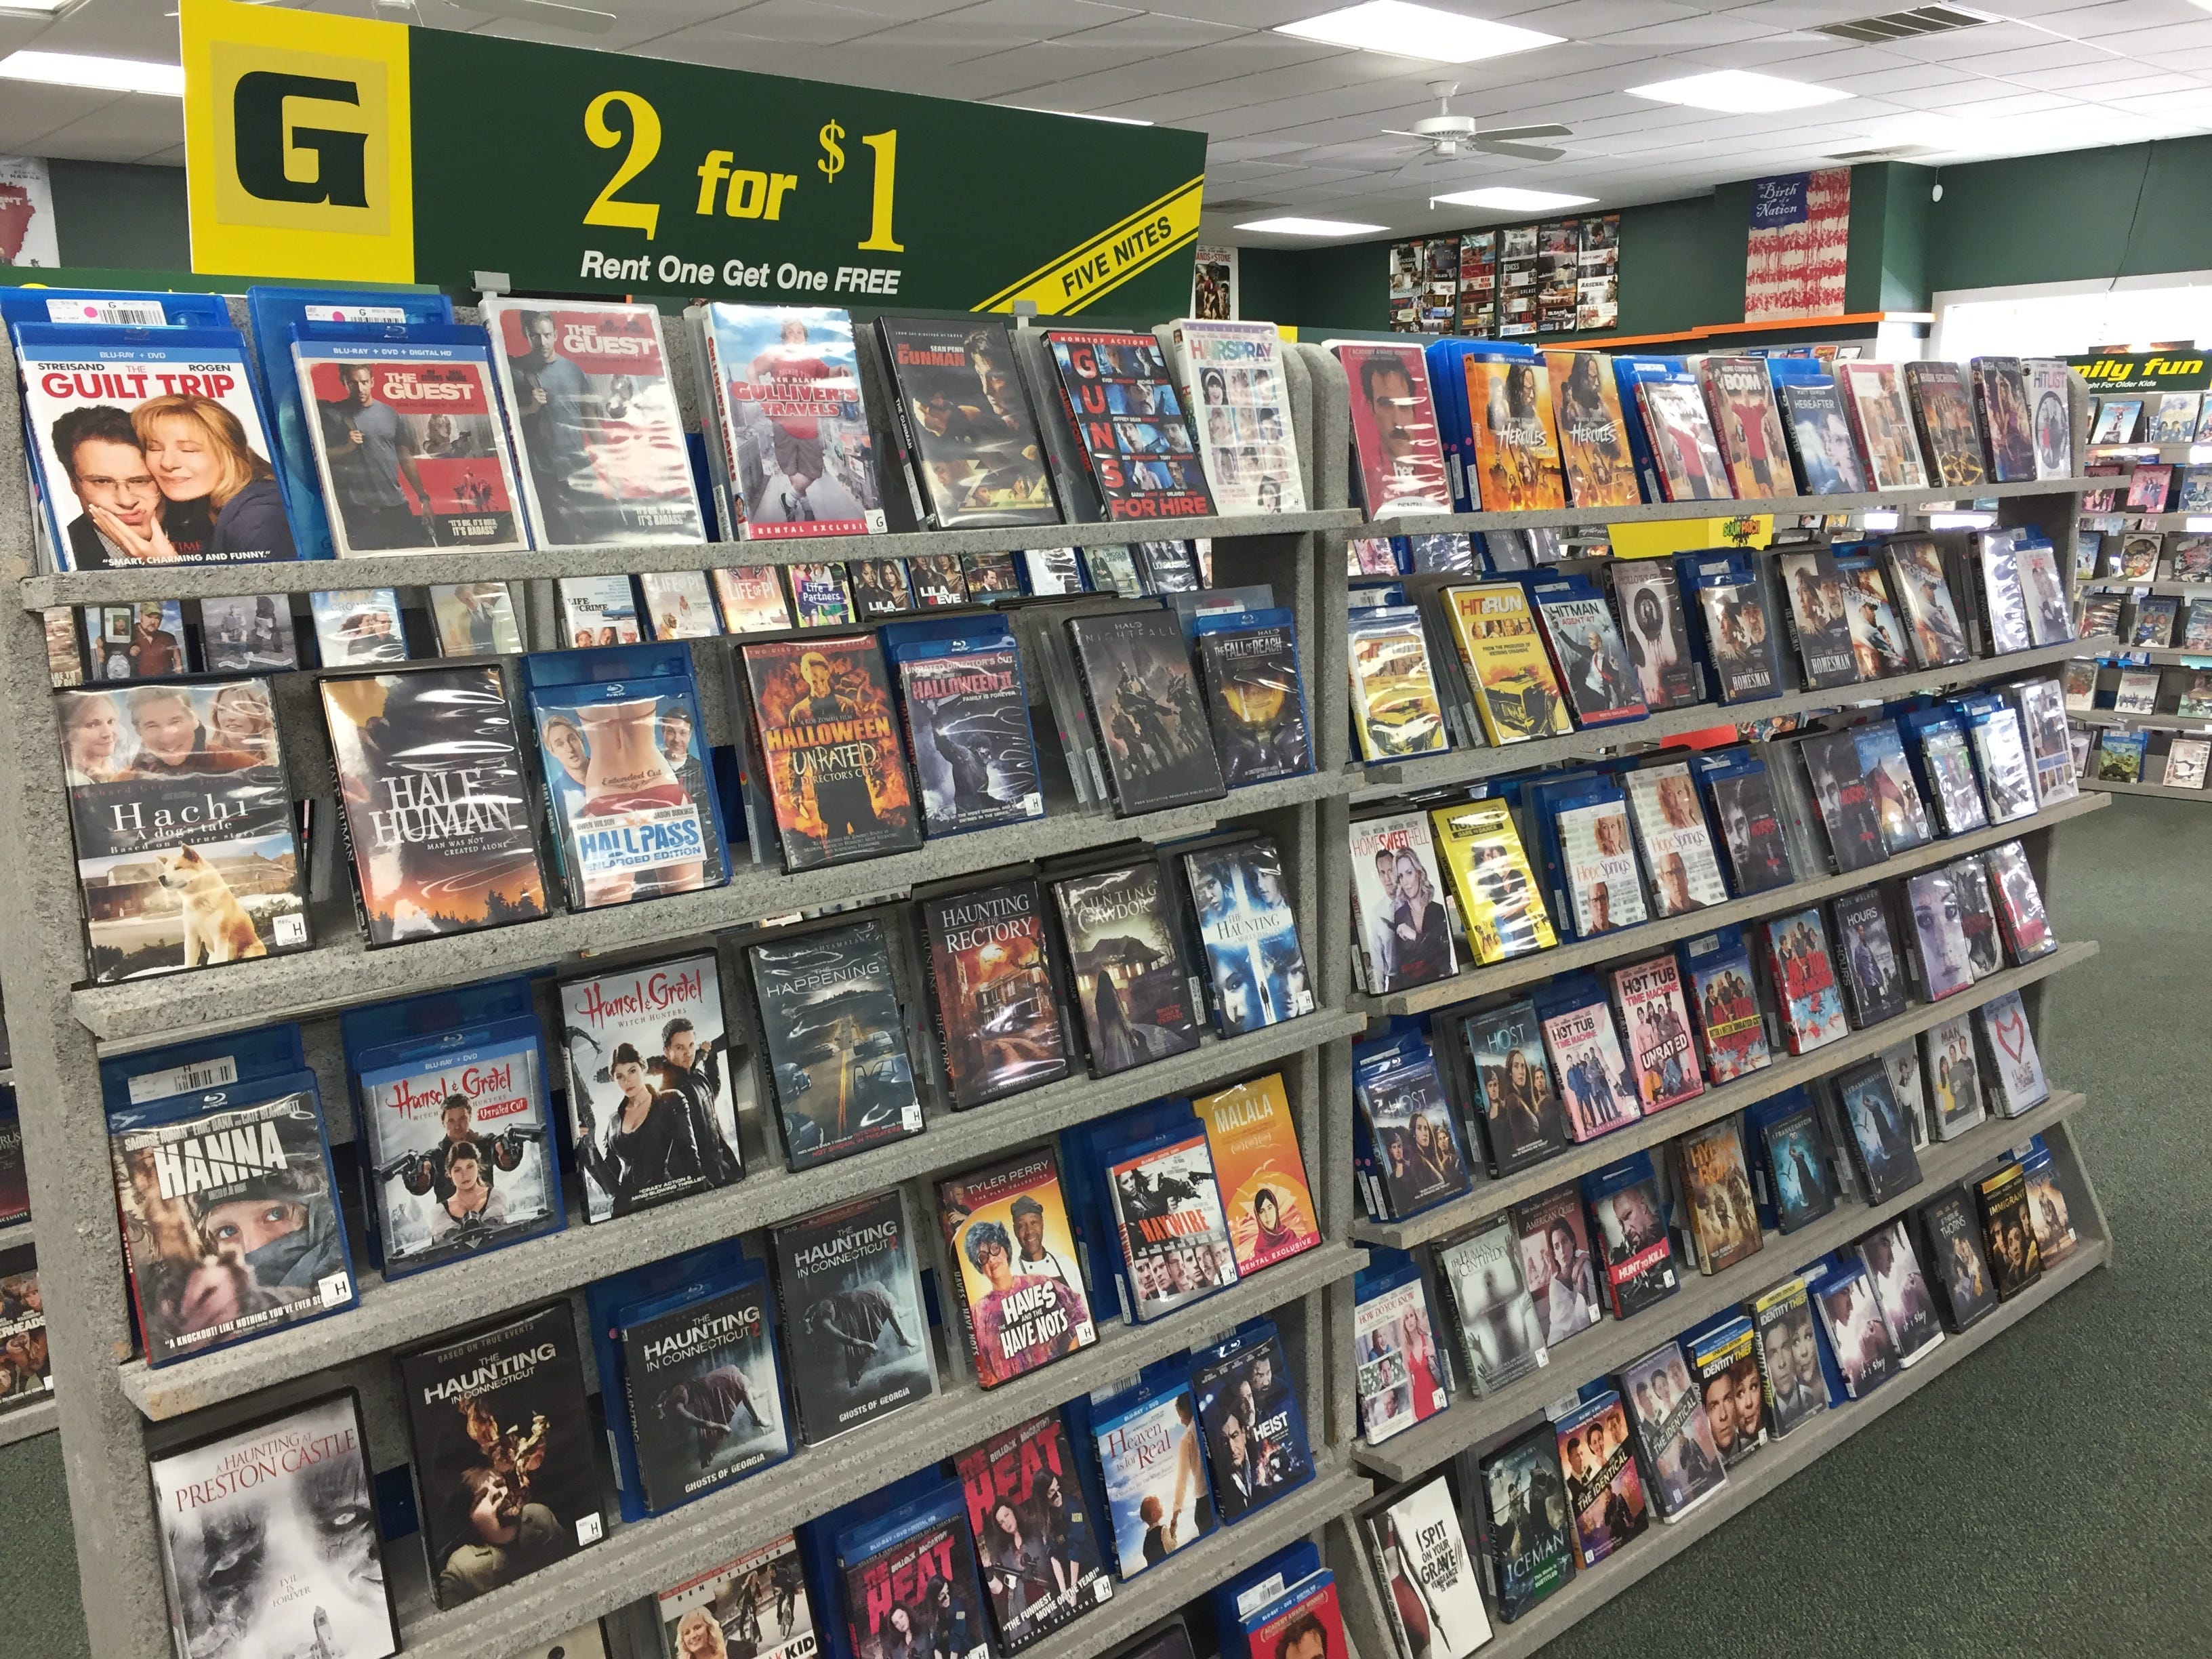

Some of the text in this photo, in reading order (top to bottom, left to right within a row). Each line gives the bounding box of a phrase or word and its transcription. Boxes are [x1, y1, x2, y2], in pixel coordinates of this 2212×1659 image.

[234, 70, 370, 208] G
[583, 91, 661, 241] 2
[696, 150, 798, 221] for
[1760, 182, 1800, 199] Birth
[1756, 198, 1797, 218] Nation
[1061, 217, 1172, 298] FIVE NITES
[581, 251, 901, 295] Rent One Get One FREE
[565, 324, 596, 336] THE
[563, 335, 654, 355] GUEST
[1191, 340, 1273, 362] HAIRSPRAY
[38, 363, 105, 371] STREISAND
[898, 350, 965, 366] GUNMAN
[2142, 359, 2203, 375] fun
[41, 373, 235, 398] GUILT TRIP
[385, 372, 417, 384] THE
[1727, 375, 1762, 391] BOOM
[1920, 373, 1958, 384] HIGH SCHOOL
[382, 383, 474, 400] GUEST
[731, 382, 859, 402] GULLIVER'S
[760, 403, 840, 417] TRAVELS
[1794, 400, 1835, 409] HEREAFTER
[1498, 423, 1546, 448] HERCULES
[1570, 422, 1617, 445] HERCULES
[1111, 499, 1156, 518] FOR
[1160, 497, 1208, 515] HIRE
[758, 525, 804, 534] RENTAL
[146, 554, 203, 564] CHARMING
[567, 598, 589, 606] LIFE
[728, 583, 753, 600] LIFE
[803, 590, 840, 602] Partners
[920, 586, 947, 597] LILA
[1549, 602, 1599, 617] HITMAN
[1086, 627, 1176, 643] NIGHTFALL
[1224, 638, 1282, 658] FALL REACH
[905, 662, 945, 674] UNRATED
[1811, 654, 1850, 674] HOMESMAN
[911, 674, 999, 701] HALLOWEEN
[1732, 672, 1771, 691] HOMESMAN
[766, 717, 892, 751] HALLOWEEN
[792, 742, 877, 775] UNRATED
[377, 768, 481, 810] HALF
[110, 793, 251, 832] Hachi
[369, 800, 512, 847] HUMAN
[201, 821, 232, 832] tale
[337, 804, 354, 861] HUMAN
[110, 843, 148, 854] Based
[445, 846, 479, 856] CREATED
[579, 820, 699, 861] HALL PASS
[654, 846, 701, 860] EDITION
[1065, 882, 1157, 915] HAUNTING
[1855, 890, 1879, 903] WALKER
[941, 894, 1030, 928] HAUNTING
[1078, 900, 1150, 932] CAWDOR
[1229, 913, 1242, 923] THE
[1846, 907, 1878, 926] HOURS
[292, 923, 302, 935] H
[944, 916, 1032, 954] RECTORY
[1217, 914, 1280, 940] HAUNTING
[767, 962, 880, 998] HAPPENING
[1622, 966, 1676, 996] HOT TUB
[575, 969, 703, 1029] Hansel Gretel
[1626, 982, 1679, 1007] TIME MACHINE
[618, 1008, 687, 1028] WITCH HUNTERS
[1551, 1017, 1594, 1042] HOT TUB
[1487, 1023, 1524, 1051] HOST
[1940, 1027, 1961, 1043] MAN
[386, 1063, 512, 1120] Hansel Gretel
[413, 1111, 438, 1121] WITCH
[1214, 1094, 1273, 1133] MALALA
[153, 1122, 288, 1200] HANNA
[966, 1160, 1049, 1194] TYLER PERRY
[1990, 1191, 2026, 1216] IMMIGRANT
[837, 1225, 853, 1235] THE
[1139, 1209, 1210, 1243] HAYWIRE
[1940, 1215, 1965, 1239] THORNS
[794, 1221, 898, 1268] HAUNTING
[1241, 1237, 1312, 1274] RENTAL EXCLUSIVE
[797, 1239, 888, 1279] IN CONNECTICUT
[1618, 1249, 1665, 1280] HUNT KILL
[335, 1283, 346, 1294] H
[1001, 1281, 1057, 1325] HAVES
[1359, 1292, 1414, 1324] HOW DO YOU KNOW
[1760, 1292, 1807, 1326] IDENTITY THIEF
[219, 1300, 312, 1335] LIKE NOTHING EVER
[692, 1313, 711, 1324] THE
[644, 1307, 760, 1361] HAUNTING
[662, 1326, 750, 1366] CONNECTICUT
[1000, 1308, 1069, 1359] HAVE NOTS
[437, 1348, 464, 1364] BASED
[478, 1353, 499, 1364] THE
[1703, 1345, 1752, 1378] IDENTITY THIEF
[424, 1343, 556, 1405] HAUNTING
[464, 1366, 535, 1400] CONNECTICUT
[839, 1387, 909, 1422] GHOSTS OF GEORGIA
[1253, 1411, 1287, 1443] HEIST
[1654, 1398, 1696, 1455] THE IDENTICAL
[224, 1433, 300, 1471] HAUNTING
[990, 1437, 1017, 1461] BULLOCK
[1107, 1422, 1162, 1459] Heaven
[1136, 1430, 1172, 1471] Real
[176, 1457, 277, 1513] PRESTON
[281, 1428, 356, 1473] CASTLE
[685, 1453, 765, 1493] GHOSTS OF GEORGIA
[964, 1420, 1062, 1536] HEAT
[1578, 1454, 1628, 1512] THE IDENTICAL
[1422, 1520, 1447, 1547] SPIT
[1431, 1539, 1450, 1557] YOUR
[1507, 1530, 1564, 1583] ICEMAN
[1421, 1553, 1456, 1584] GRAVE
[1431, 1568, 1458, 1591] VENGEANCE
[272, 1586, 311, 1607] FOREVER
[867, 1534, 954, 1635] HEAT
